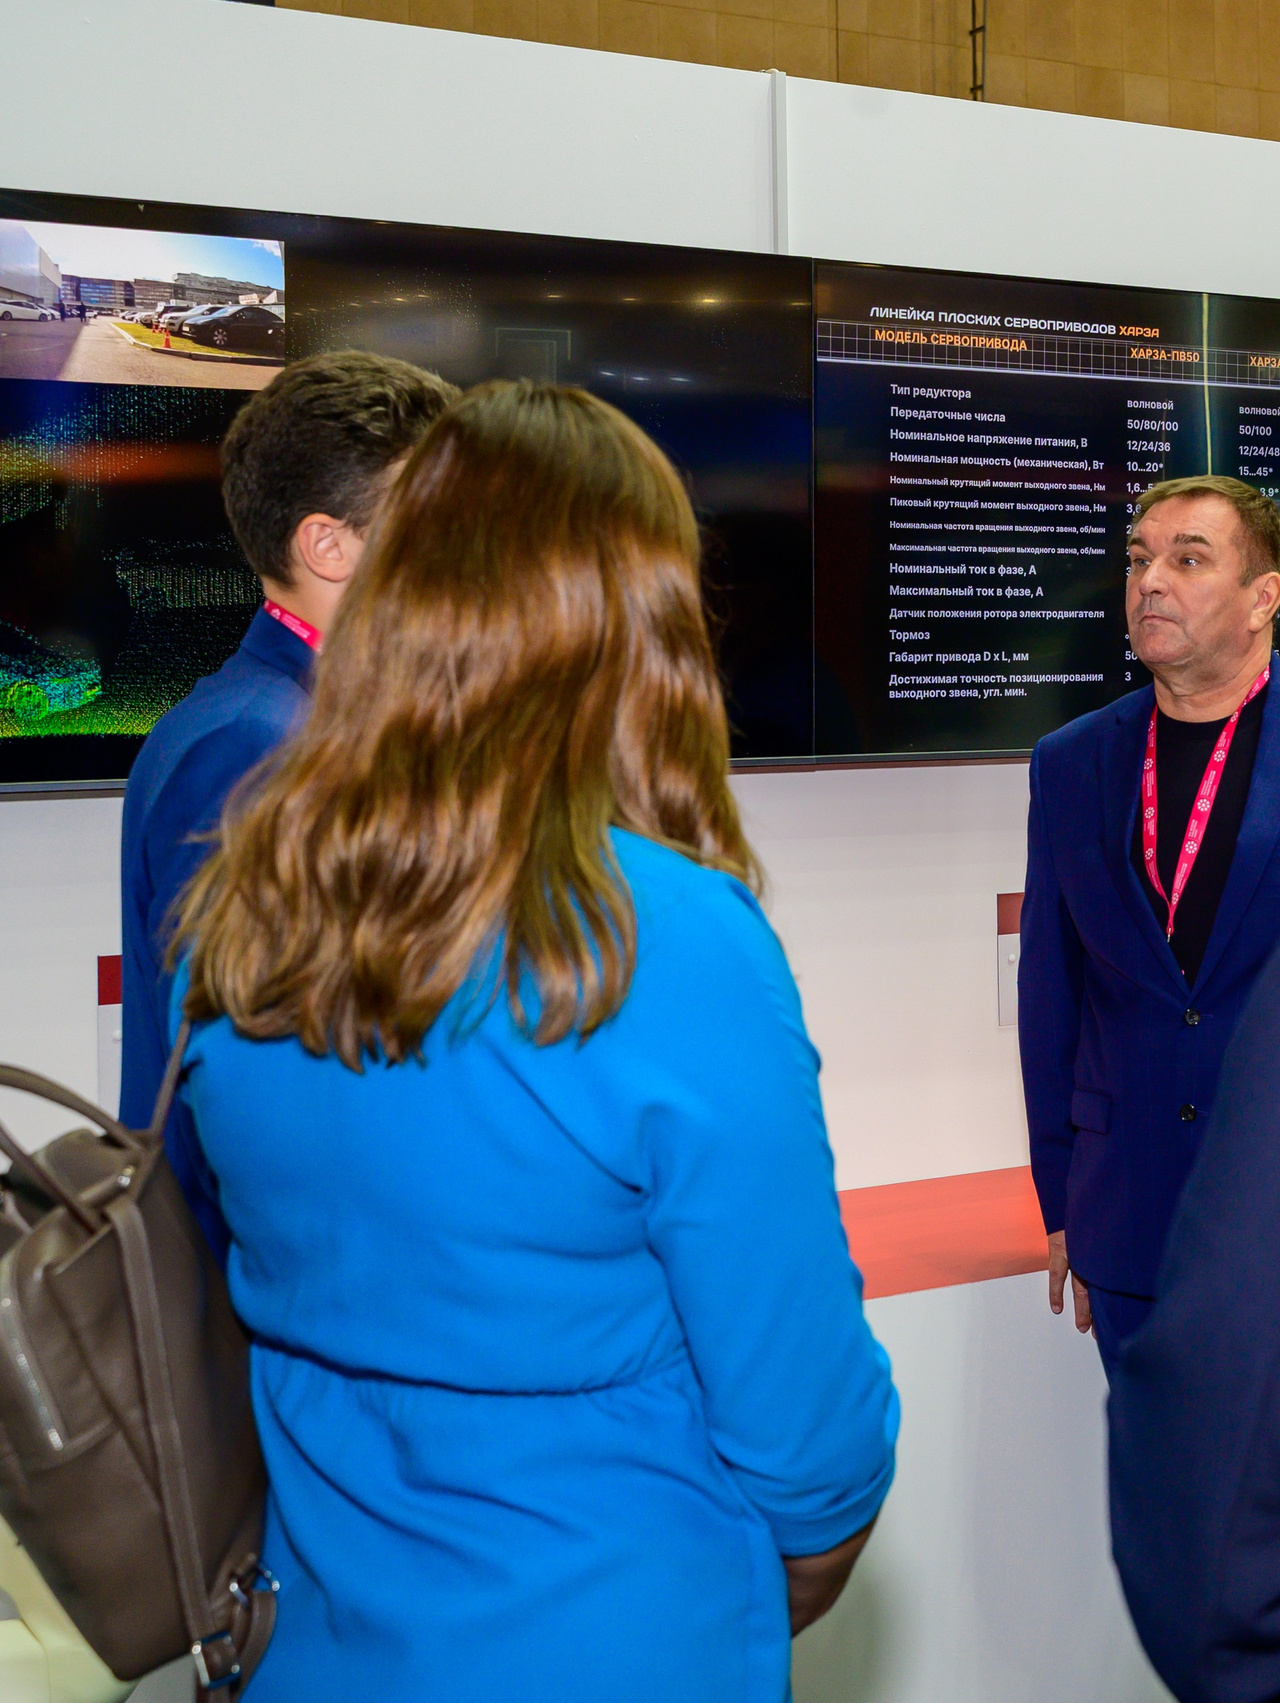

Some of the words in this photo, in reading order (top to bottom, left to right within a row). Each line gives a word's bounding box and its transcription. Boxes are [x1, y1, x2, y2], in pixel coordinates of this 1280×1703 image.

[870, 307, 934, 321] ЛИНЕЙКА
[938, 312, 1001, 326] ПЛОСКИХ
[1004, 317, 1116, 335] СЕРВОПРИВОДОВ
[1119, 326, 1160, 338] ХАРЗА
[874, 330, 928, 343] МОДЕЛЬ
[930, 334, 1027, 351] СЕРВОПРИВОДА
[1130, 348, 1200, 362] ХАРЗА-ПВ50
[890, 384, 910, 397] Тип
[913, 387, 971, 399] редуктора
[1127, 400, 1173, 410] волновой
[890, 407, 971, 421] Передаточные
[974, 412, 1005, 422] числа
[1127, 419, 1178, 431] 50/80/100
[1239, 426, 1272, 436] 50/100
[890, 429, 965, 442] Номинальное
[967, 434, 1032, 446] напряжение
[1035, 437, 1079, 449] питания,
[1081, 438, 1087, 447] В
[1127, 441, 1170, 452] 12/24/36
[1238, 446, 1280, 457] 12/24/48
[890, 452, 958, 465] Номинальная
[960, 456, 1011, 467] мощность
[1013, 457, 1091, 471] (механическая),
[1093, 460, 1104, 470] Вт
[890, 476, 948, 486] Номинальный
[950, 479, 991, 489] крутящий
[992, 480, 1023, 488] момент
[1025, 481, 1067, 491] выходного
[1068, 483, 1092, 491] звена,
[1094, 483, 1105, 491] Нм
[890, 498, 931, 507] Пиковый
[933, 499, 979, 510] крутящий
[1016, 503, 1063, 512] выходного
[1065, 505, 1092, 513] звена,
[1093, 504, 1106, 512] Нм
[890, 521, 942, 530] Номинальная
[944, 523, 974, 531] частота
[975, 524, 1013, 532] вращения
[1015, 525, 1055, 533] выходного
[1056, 526, 1079, 534] звена,
[890, 544, 946, 552] Максимальная
[948, 545, 977, 553] частота
[978, 546, 1015, 554] вращения
[1016, 547, 1055, 555] выходного
[1057, 548, 1079, 556] звена,
[890, 563, 967, 575] Номинальный
[969, 565, 988, 574] ток
[998, 565, 1027, 577] фазе,
[1029, 565, 1037, 575] А
[890, 585, 974, 597] Максимальный
[976, 587, 994, 597] ток
[996, 589, 1003, 597] в
[1005, 588, 1034, 600] фазе,
[1036, 587, 1044, 597] А
[889, 608, 926, 620] Датчик
[927, 609, 982, 618] положения
[983, 610, 1018, 619] ротора
[1019, 609, 1105, 619] электродвигателя
[889, 630, 930, 641] Тормоз
[889, 652, 933, 664] Габарит
[936, 653, 981, 664] привода
[983, 652, 991, 661] D
[1002, 652, 1011, 663] L,
[1013, 653, 1028, 661] мм
[889, 674, 958, 686] Достижимая
[960, 674, 1007, 684] точность
[1009, 673, 1104, 683] позиционирования
[1125, 672, 1132, 681] 3
[889, 688, 947, 699] выходного
[948, 688, 981, 699] звена,
[983, 687, 1003, 698] угл.
[1004, 687, 1027, 697] мин.
